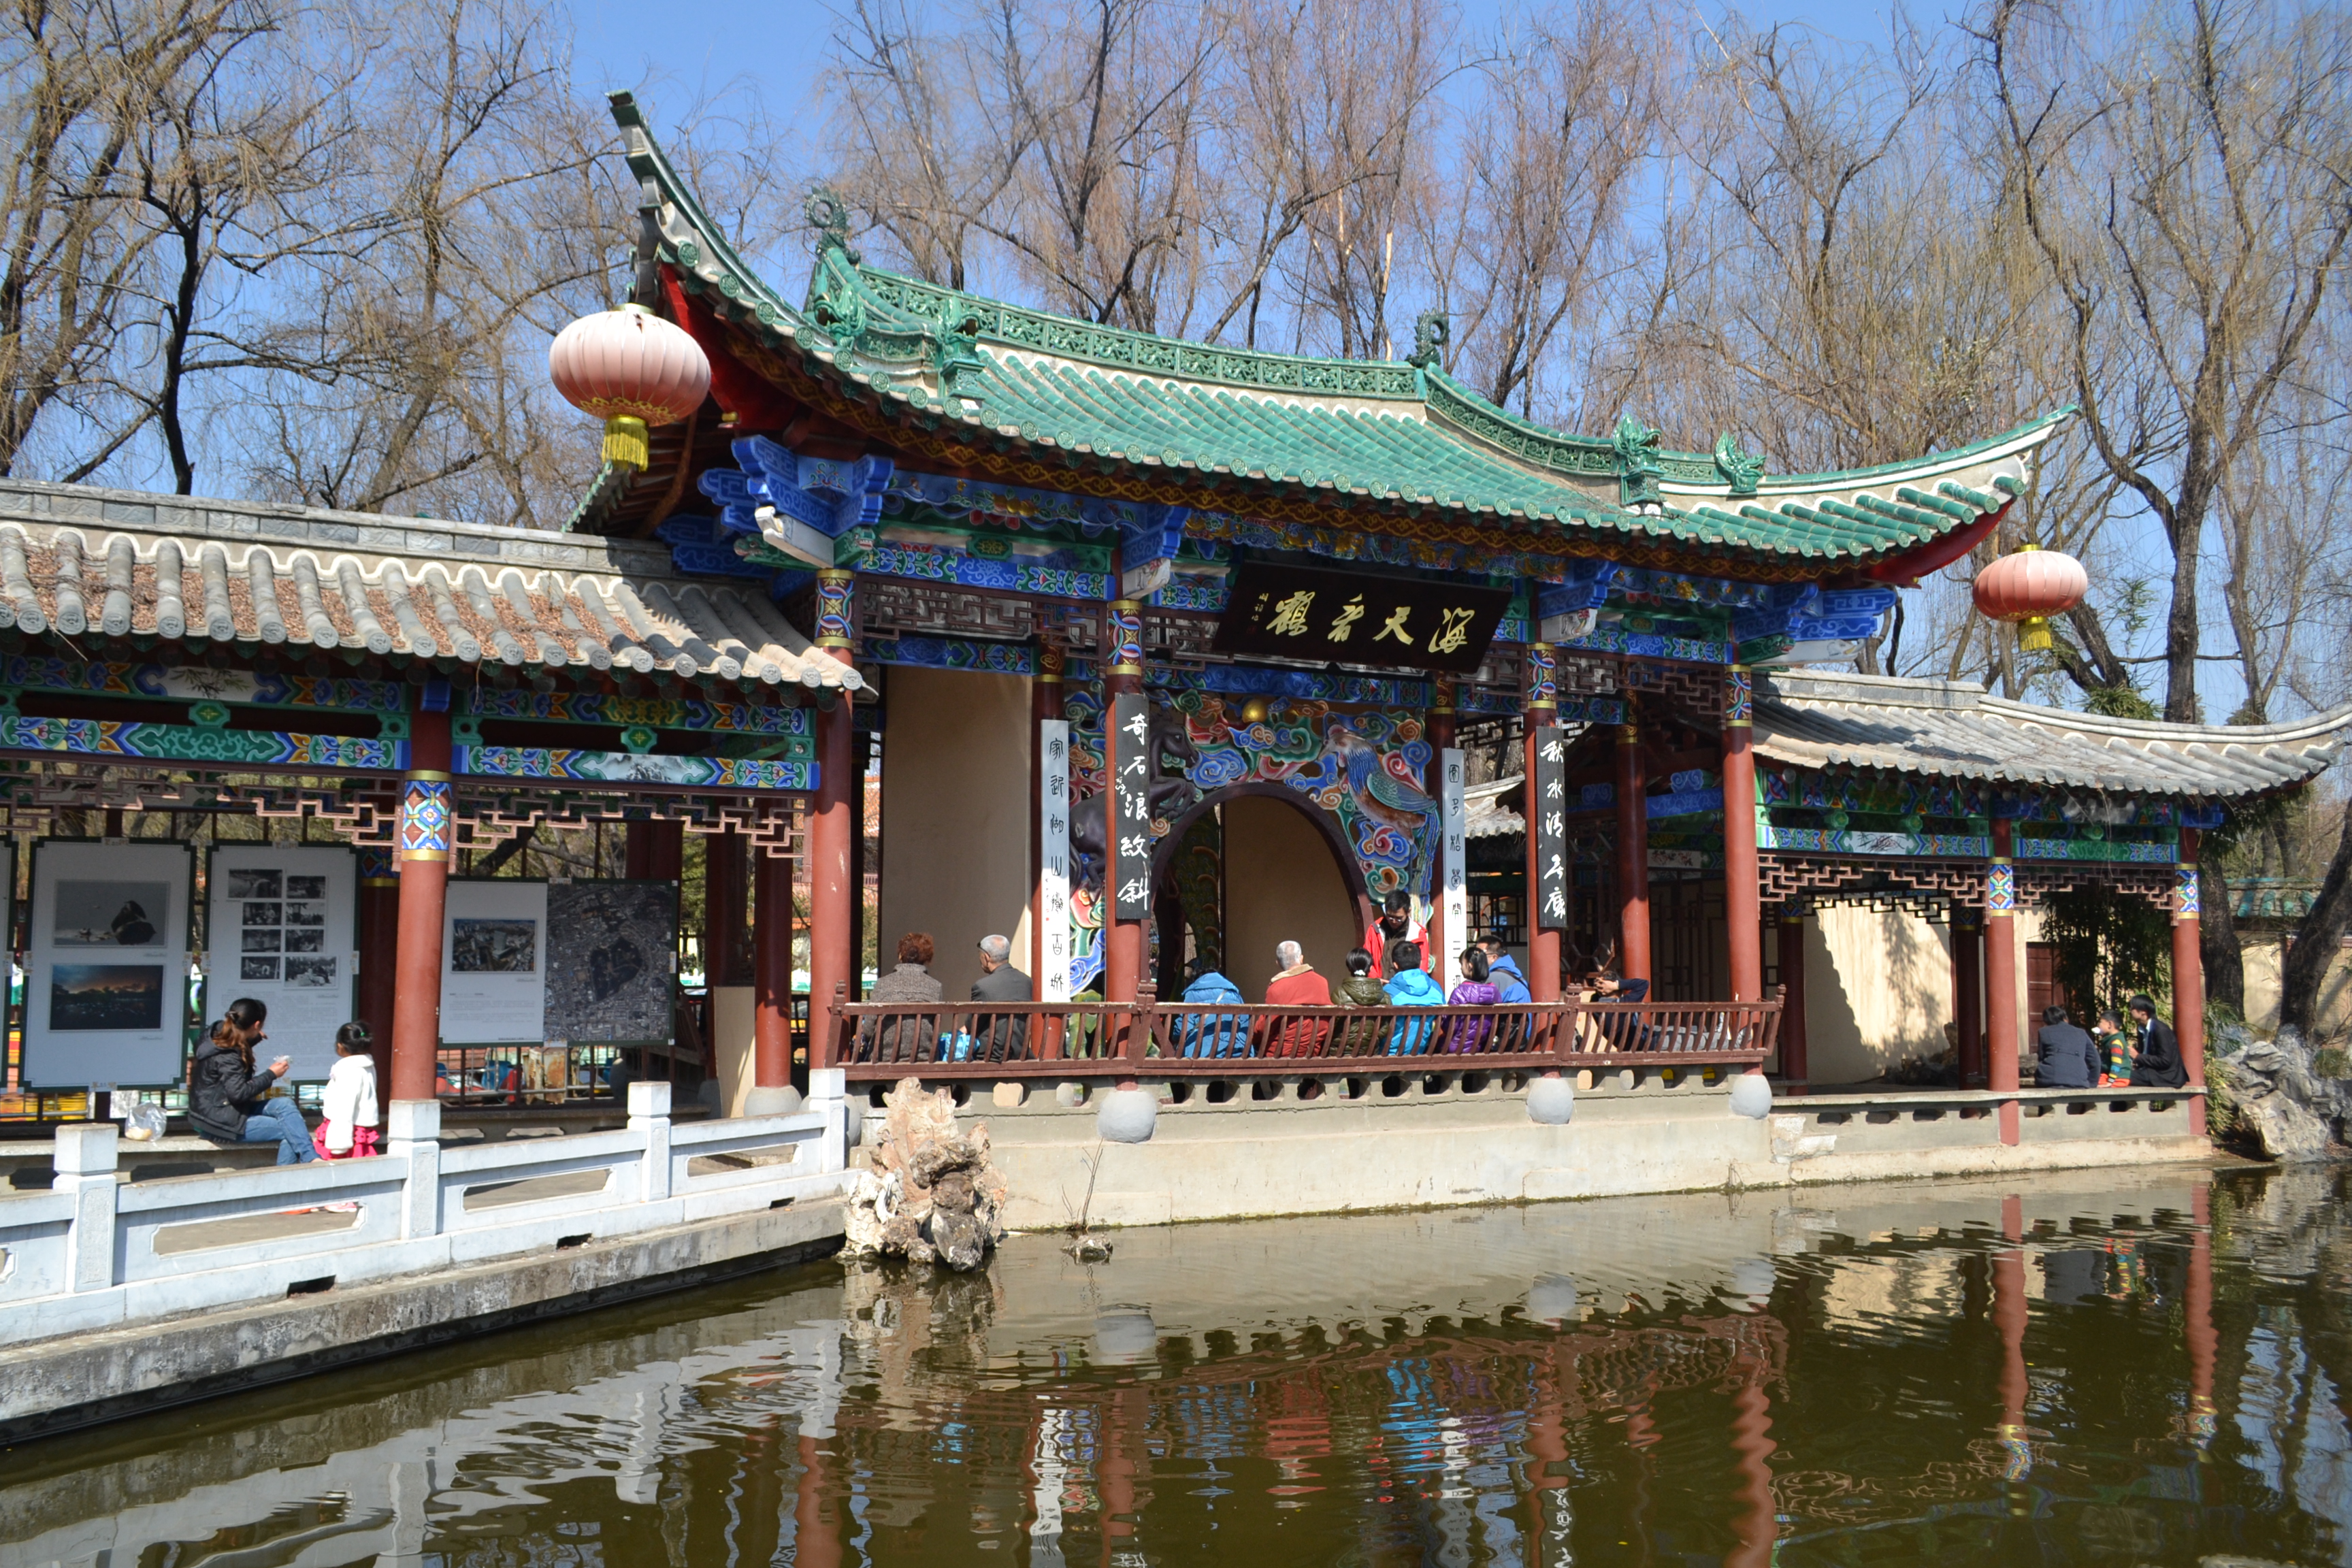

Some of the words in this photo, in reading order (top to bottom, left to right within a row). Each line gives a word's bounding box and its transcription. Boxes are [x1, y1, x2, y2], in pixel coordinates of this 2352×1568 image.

[1117, 713, 1149, 911] 奇石浪紋斜
